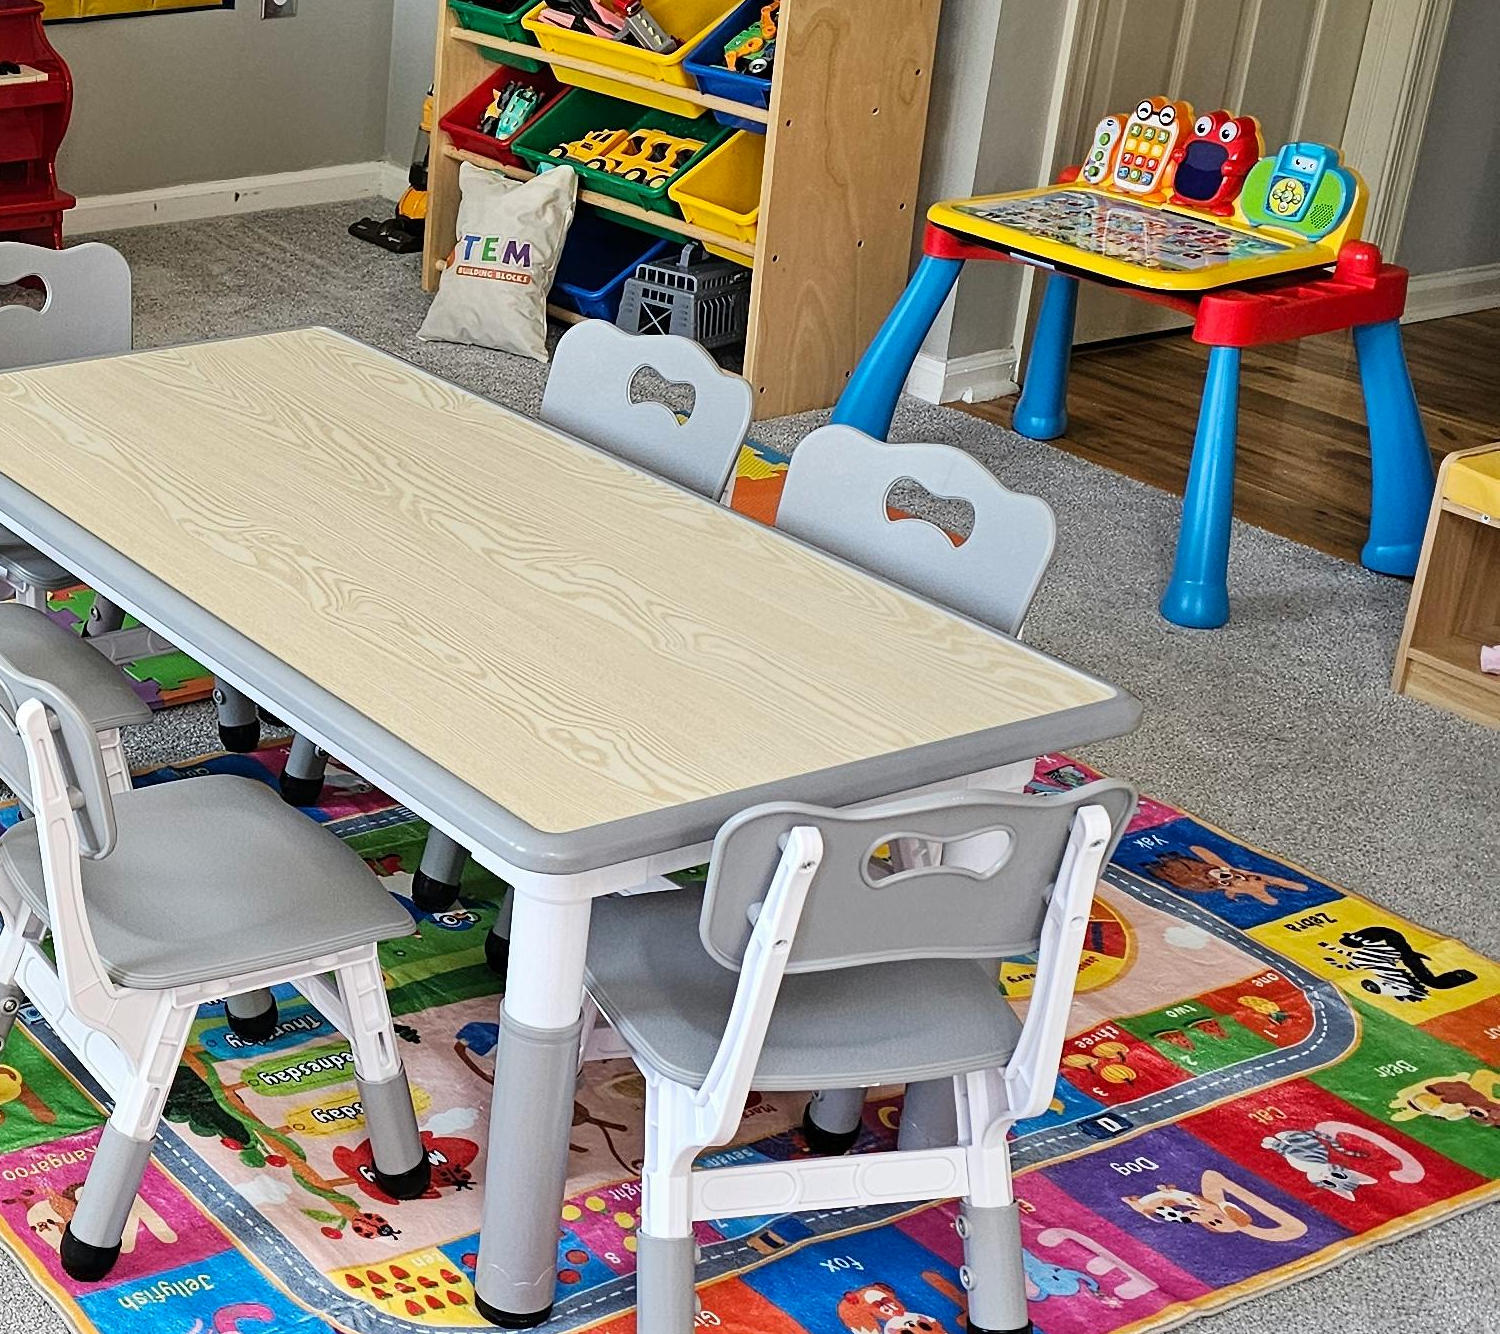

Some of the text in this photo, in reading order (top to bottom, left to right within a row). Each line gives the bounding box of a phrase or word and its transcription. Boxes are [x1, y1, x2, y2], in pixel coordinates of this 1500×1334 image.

[1124, 153, 1130, 162] 7
[458, 267, 528, 283] BUILDING BLOCKS
[1133, 834, 1169, 851] Yak
[1284, 912, 1338, 933] Zebra
[1252, 971, 1280, 988] one
[1165, 1004, 1198, 1019] two
[224, 1014, 323, 1049] Thuray
[258, 1049, 355, 1087] ednesday
[1075, 1025, 1120, 1097] three 3
[1378, 1059, 1420, 1079] Bear
[311, 1100, 365, 1125] sday
[1248, 1106, 1288, 1124] Cat
[702, 1147, 755, 1166] seven
[1313, 1120, 1426, 1184] C
[1109, 1156, 1159, 1176] Dog
[608, 1182, 643, 1203] ight
[1200, 1169, 1308, 1242] D
[604, 1251, 621, 1265] 8
[118, 1273, 216, 1312] Jellyfish
